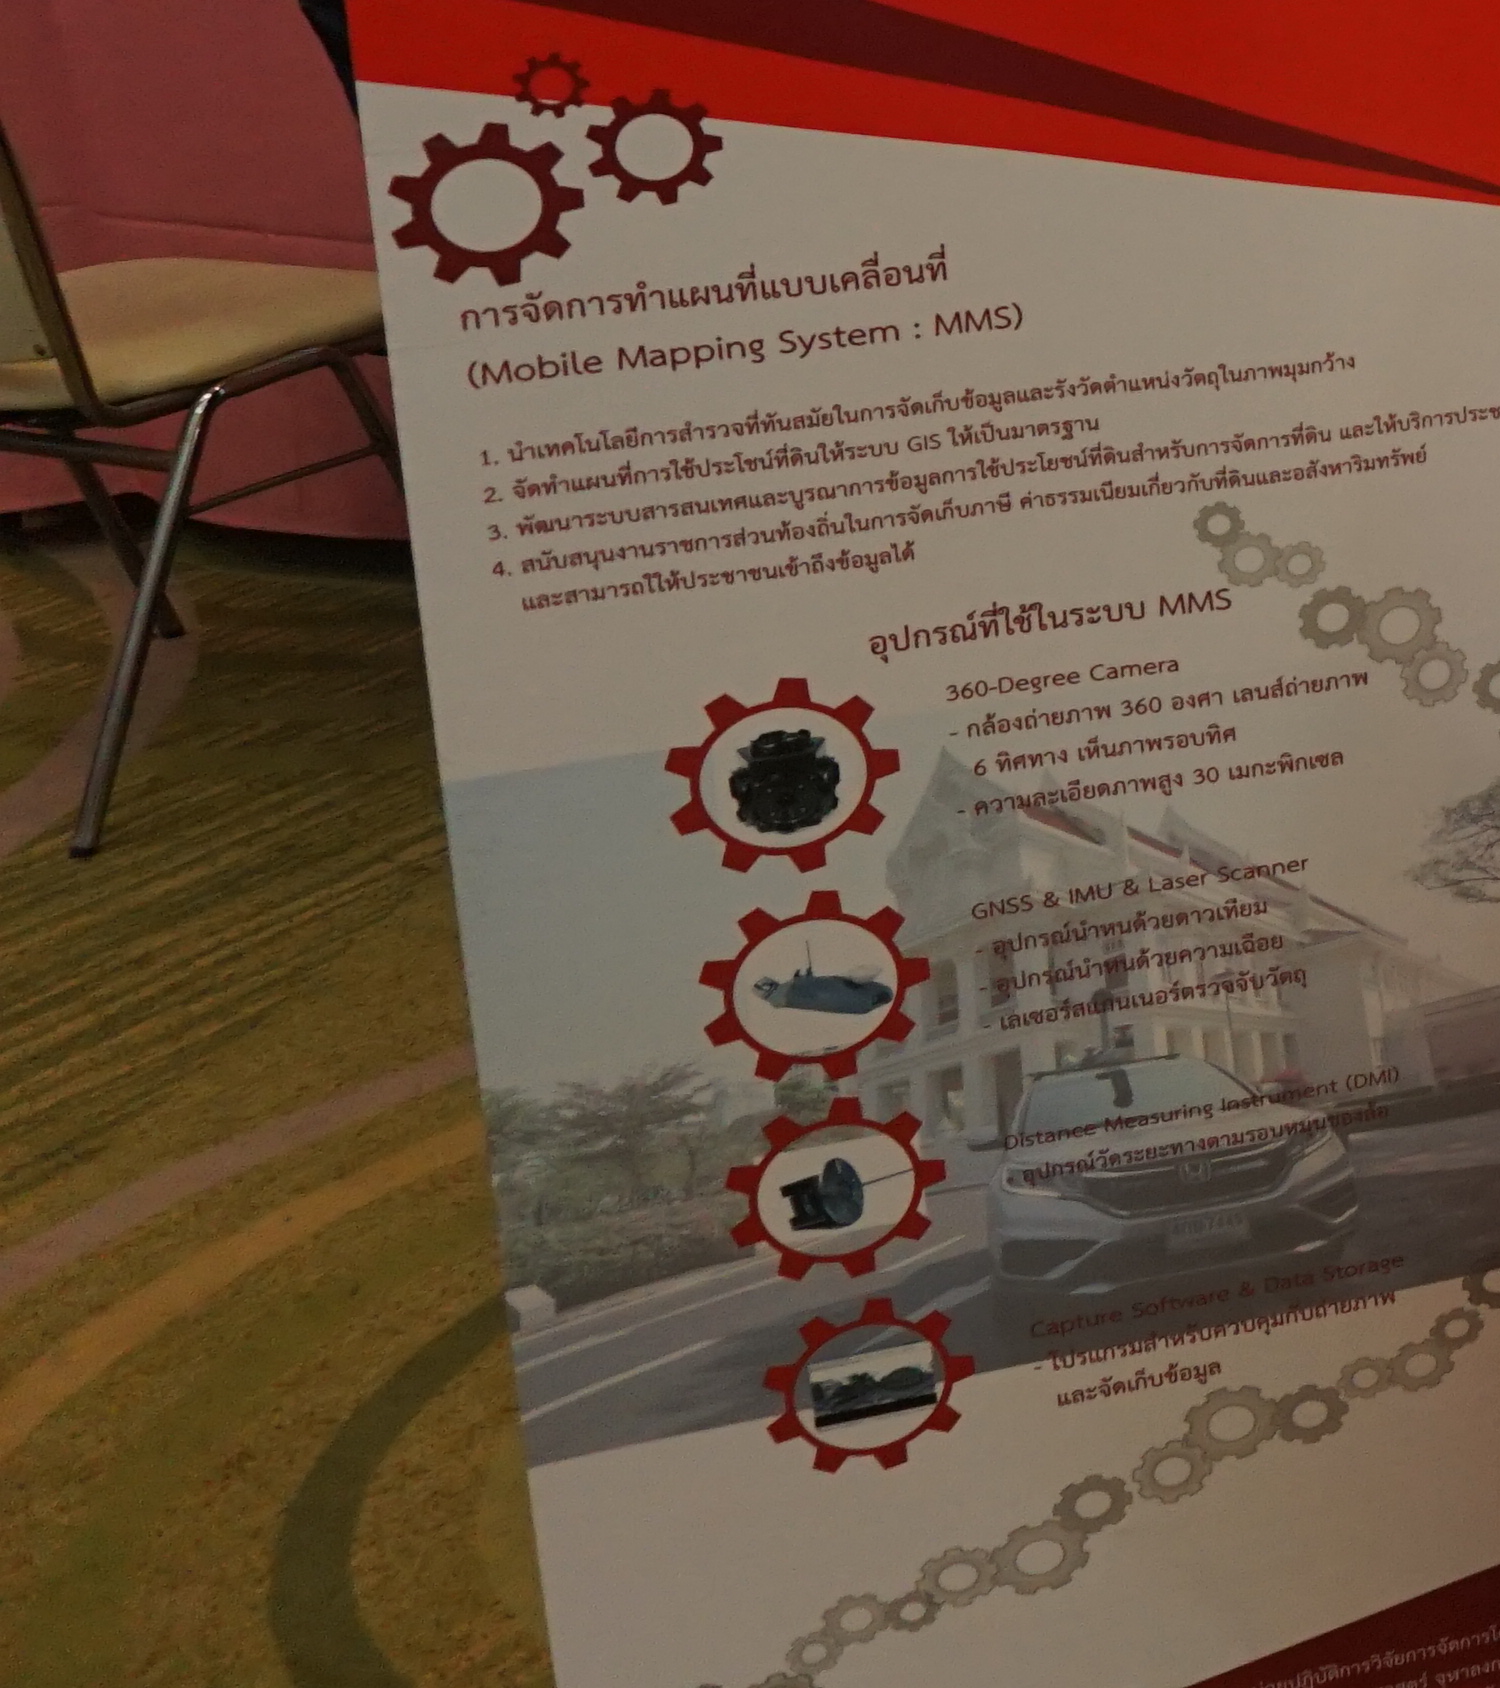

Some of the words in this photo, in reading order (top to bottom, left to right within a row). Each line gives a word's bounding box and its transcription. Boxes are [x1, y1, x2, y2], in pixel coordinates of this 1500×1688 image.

[460, 244, 949, 332] การจัดการทำแผนที่แบบเคลื่อนที่
[467, 349, 604, 391] (Mobile
[616, 336, 765, 378] Mapping
[778, 320, 901, 359] System
[933, 301, 1024, 338] MMS)
[907, 429, 943, 453] GIS
[946, 411, 1101, 448] ให้เป็นมาตรฐาน
[869, 596, 1146, 663] อุปกรณ์ที่ใช้ในระบบ
[1157, 587, 1233, 617] MMS
[944, 665, 1082, 704] 360-Degree
[1089, 654, 1180, 685] Camera
[966, 700, 1113, 743] กล้องถ่ายภาพ
[1120, 694, 1163, 716] 360
[1170, 687, 1224, 713] องศา
[1232, 670, 1369, 704] เลนส์ถ่ายภาพ
[972, 758, 987, 778] 6
[994, 746, 1070, 777] ทิศทาง
[1076, 723, 1238, 765] เห็นภาพรอบทิศ
[973, 771, 1186, 818] ความละเอียดภาพสูง
[1193, 765, 1220, 785] 30
[1227, 748, 1345, 782] เมกะพิกเซล
[971, 892, 1034, 922] GNSS
[1043, 888, 1062, 909] &
[1068, 881, 1114, 907] IMU
[1123, 877, 1141, 898] &
[1147, 866, 1208, 894] Laser
[1217, 853, 1310, 886] Scanner
[1003, 1120, 1099, 1152] Distance
[1104, 1098, 1214, 1136] Measuring
[1056, 1357, 1222, 1410] และจัดเก็บข้อมูล
